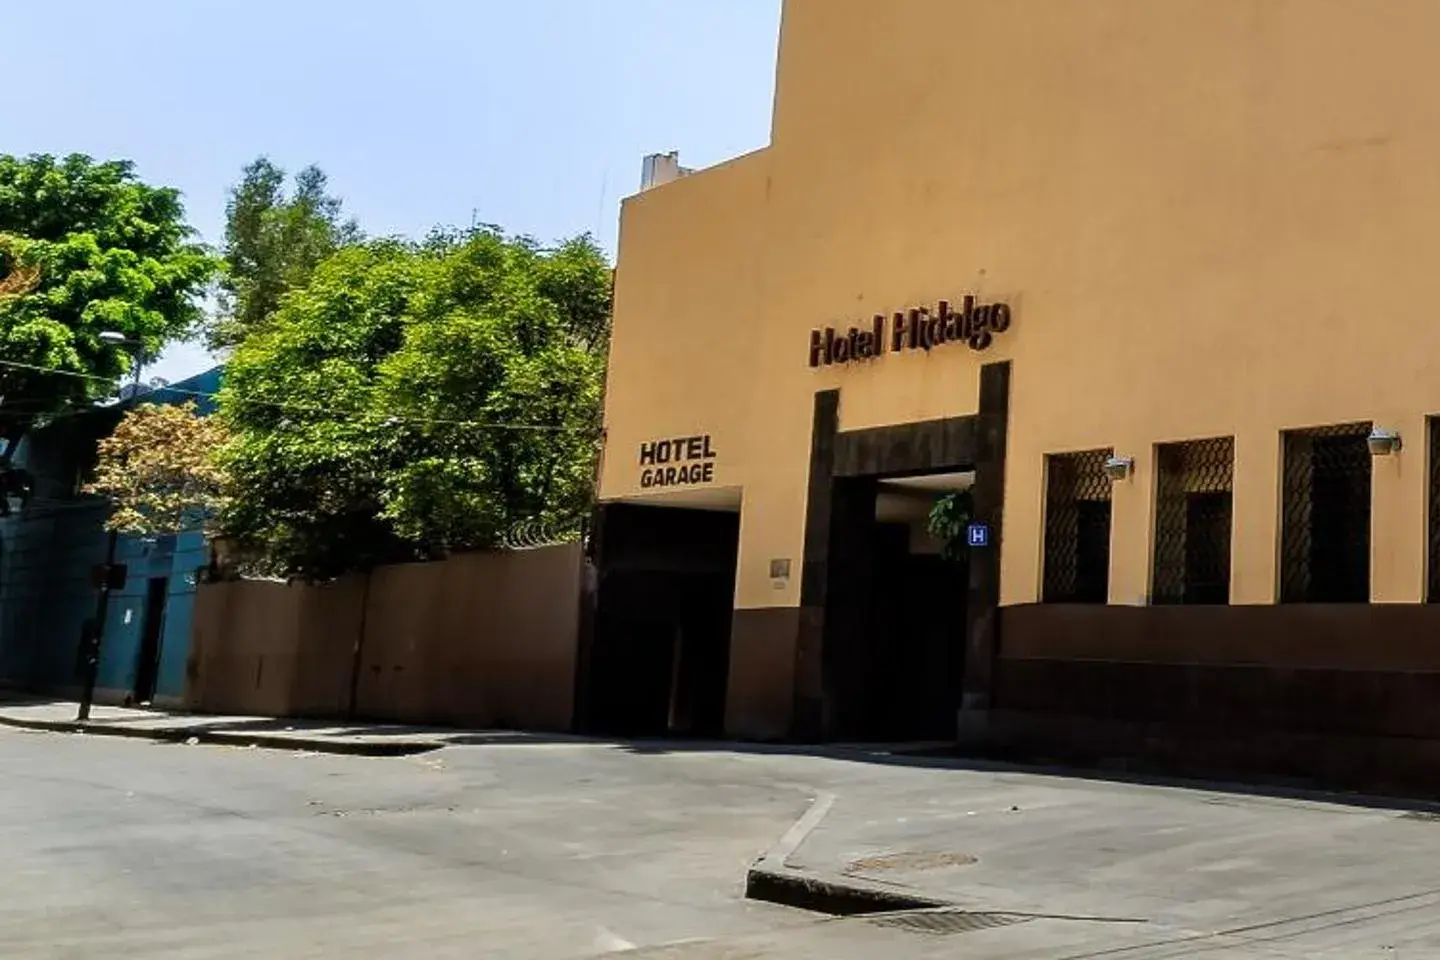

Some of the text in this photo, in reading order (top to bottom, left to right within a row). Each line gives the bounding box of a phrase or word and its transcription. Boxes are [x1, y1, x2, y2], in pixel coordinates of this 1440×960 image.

[809, 295, 1011, 367] Hotel Hidalgo
[640, 435, 716, 466] HOTEL
[640, 462, 714, 488] GARAGE
[972, 528, 984, 542] H
